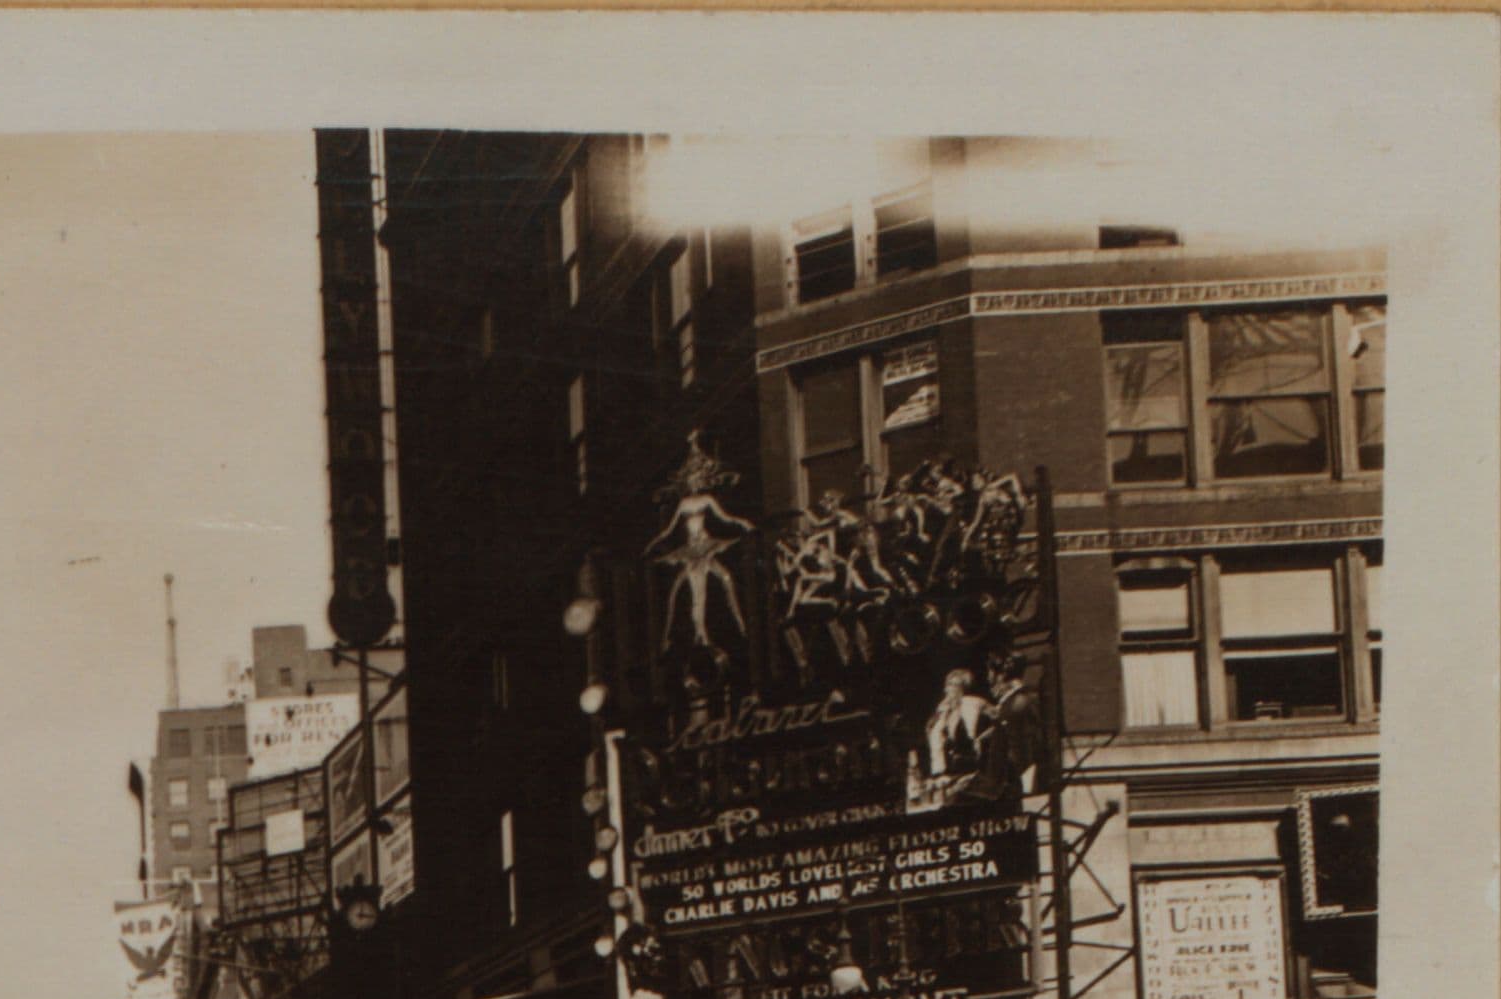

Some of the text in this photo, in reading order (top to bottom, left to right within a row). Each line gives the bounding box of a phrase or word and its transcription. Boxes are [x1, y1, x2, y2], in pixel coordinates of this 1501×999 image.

[681, 882, 705, 902] 50
[712, 871, 782, 897] WORLDS
[894, 845, 952, 870] GIRLS
[958, 840, 986, 860] 50
[663, 898, 737, 925] CHARLIE
[742, 889, 800, 914] DAVIS
[806, 883, 844, 905] AND
